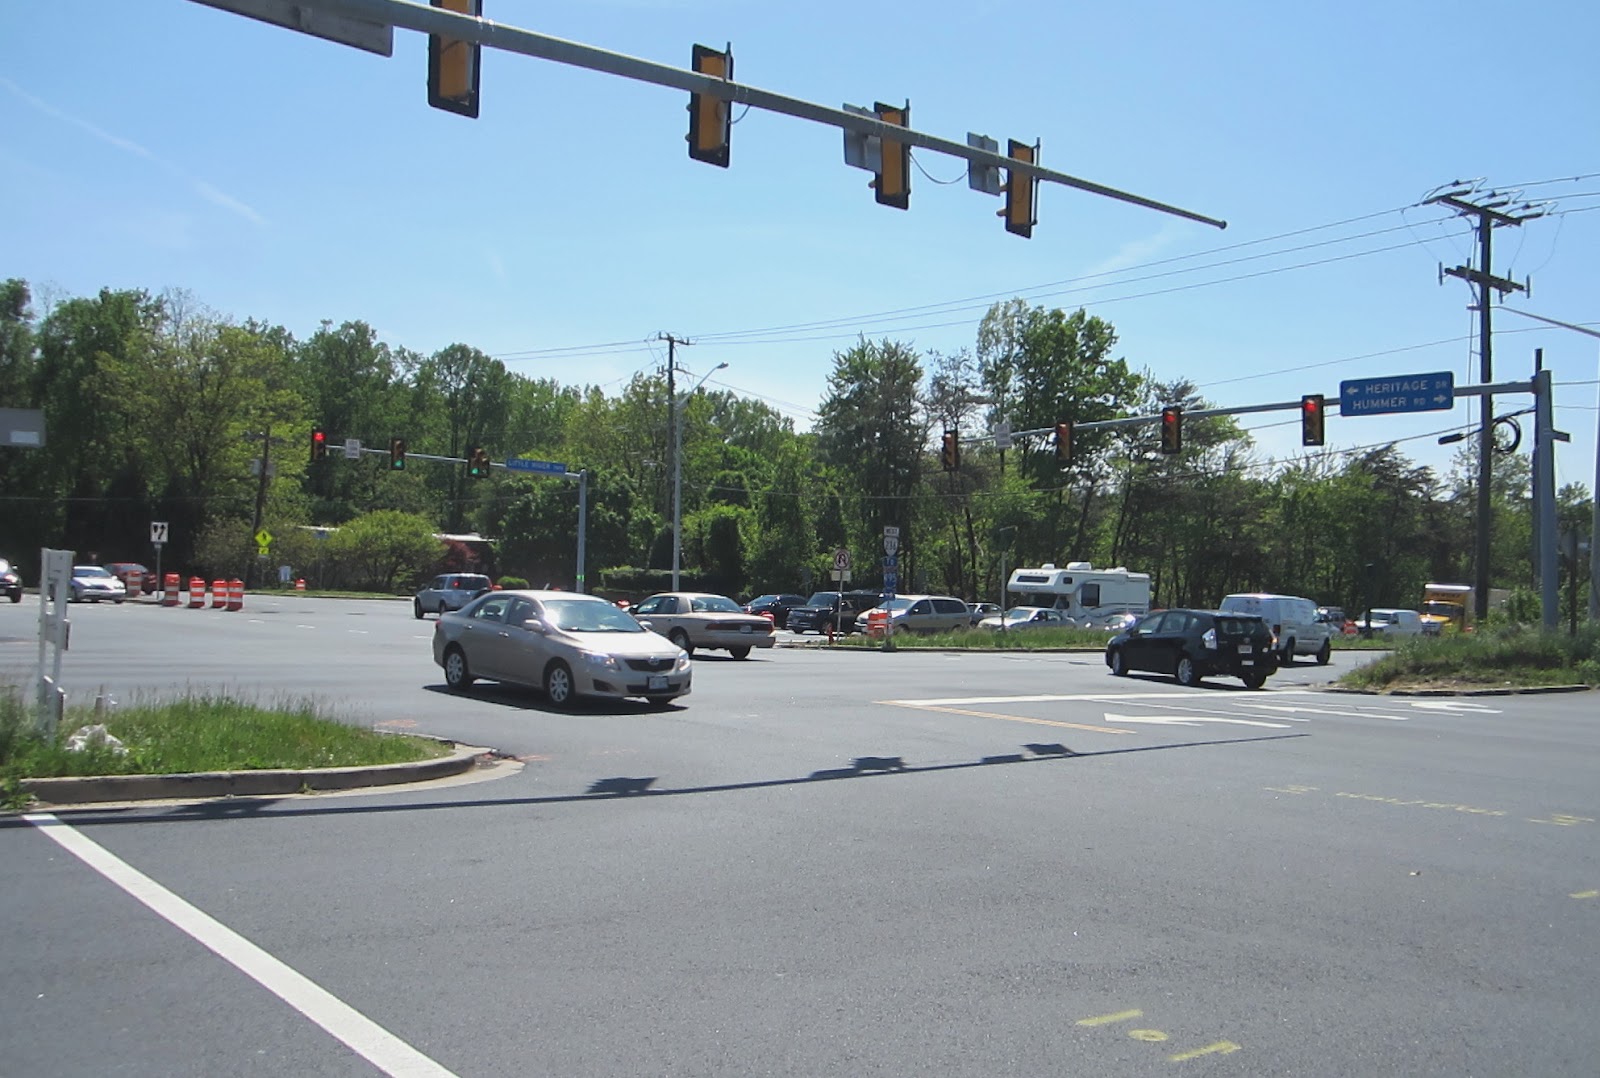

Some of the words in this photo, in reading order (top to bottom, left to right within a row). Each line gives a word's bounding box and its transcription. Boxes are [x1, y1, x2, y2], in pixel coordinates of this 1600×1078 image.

[1365, 380, 1428, 395] HERITAGE
[1435, 381, 1447, 390] DR
[1352, 397, 1407, 410] HUMMER
[1413, 398, 1426, 406] RD
